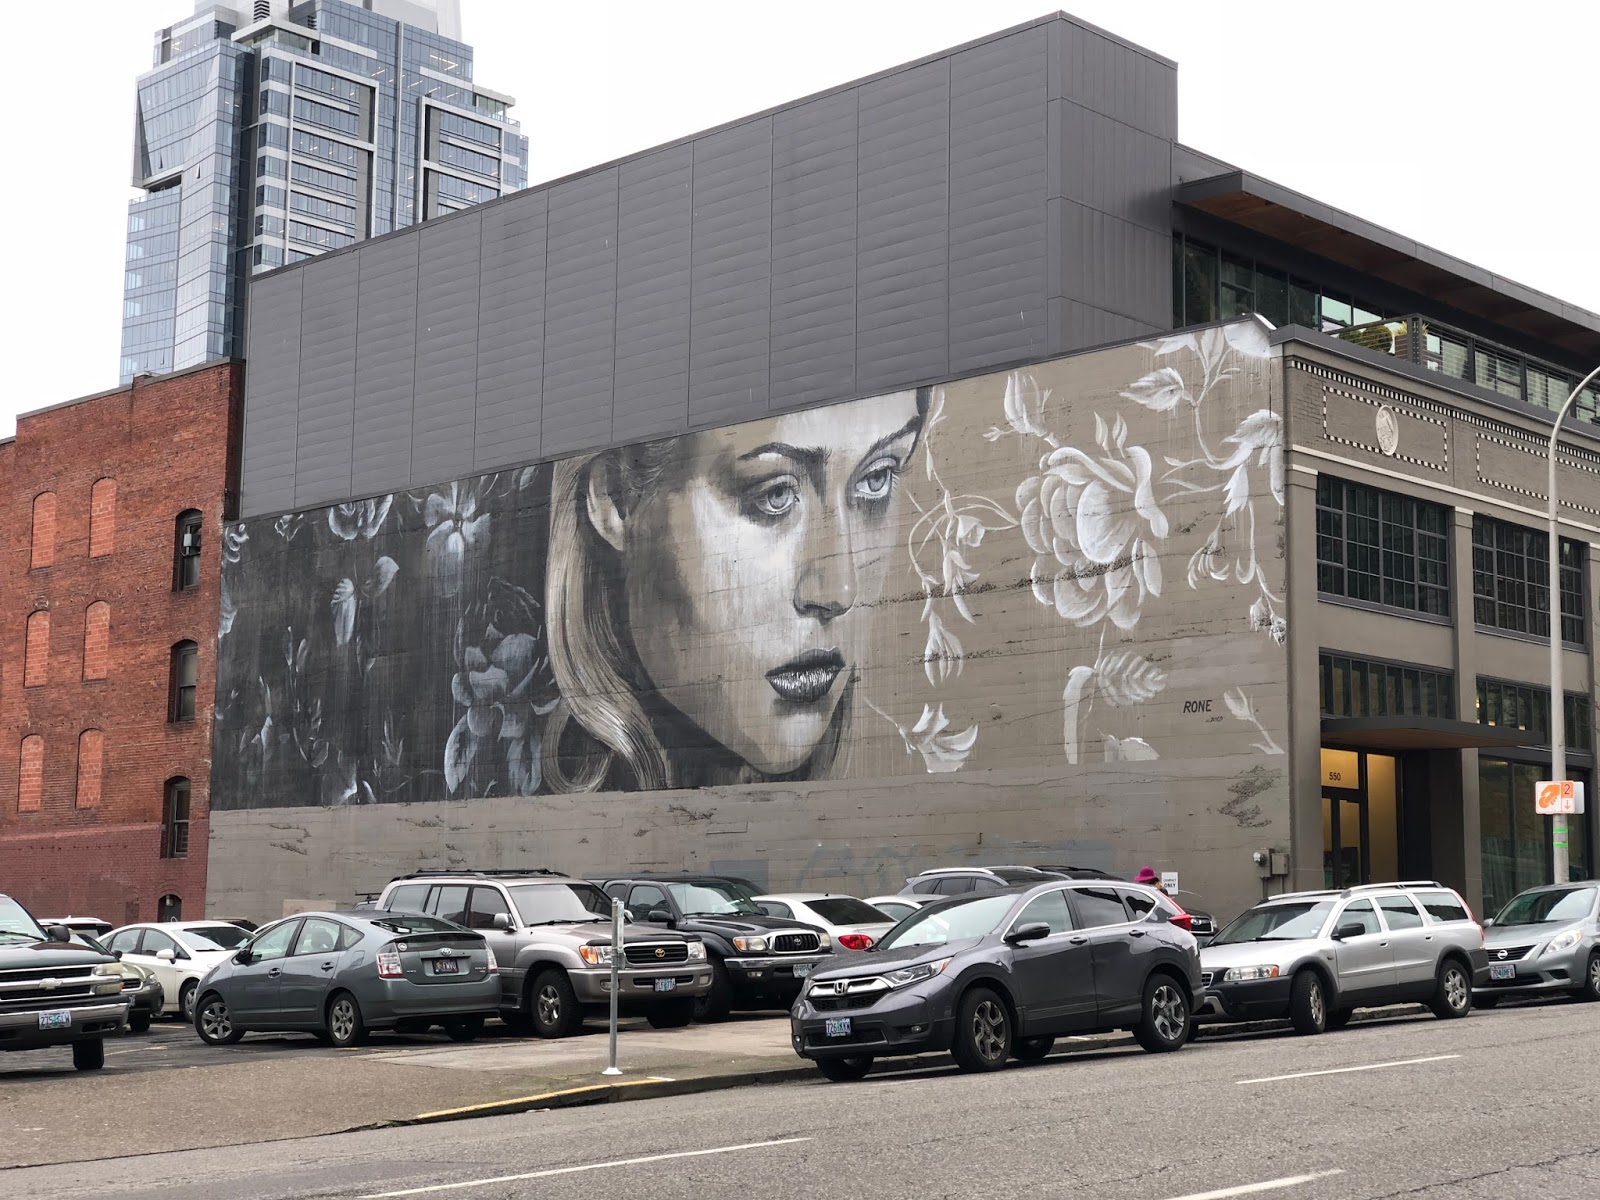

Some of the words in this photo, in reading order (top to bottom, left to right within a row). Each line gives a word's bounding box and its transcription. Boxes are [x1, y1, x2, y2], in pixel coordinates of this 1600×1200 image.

[1183, 699, 1212, 713] RONE
[1329, 771, 1341, 781] 550
[1564, 783, 1571, 795] 2
